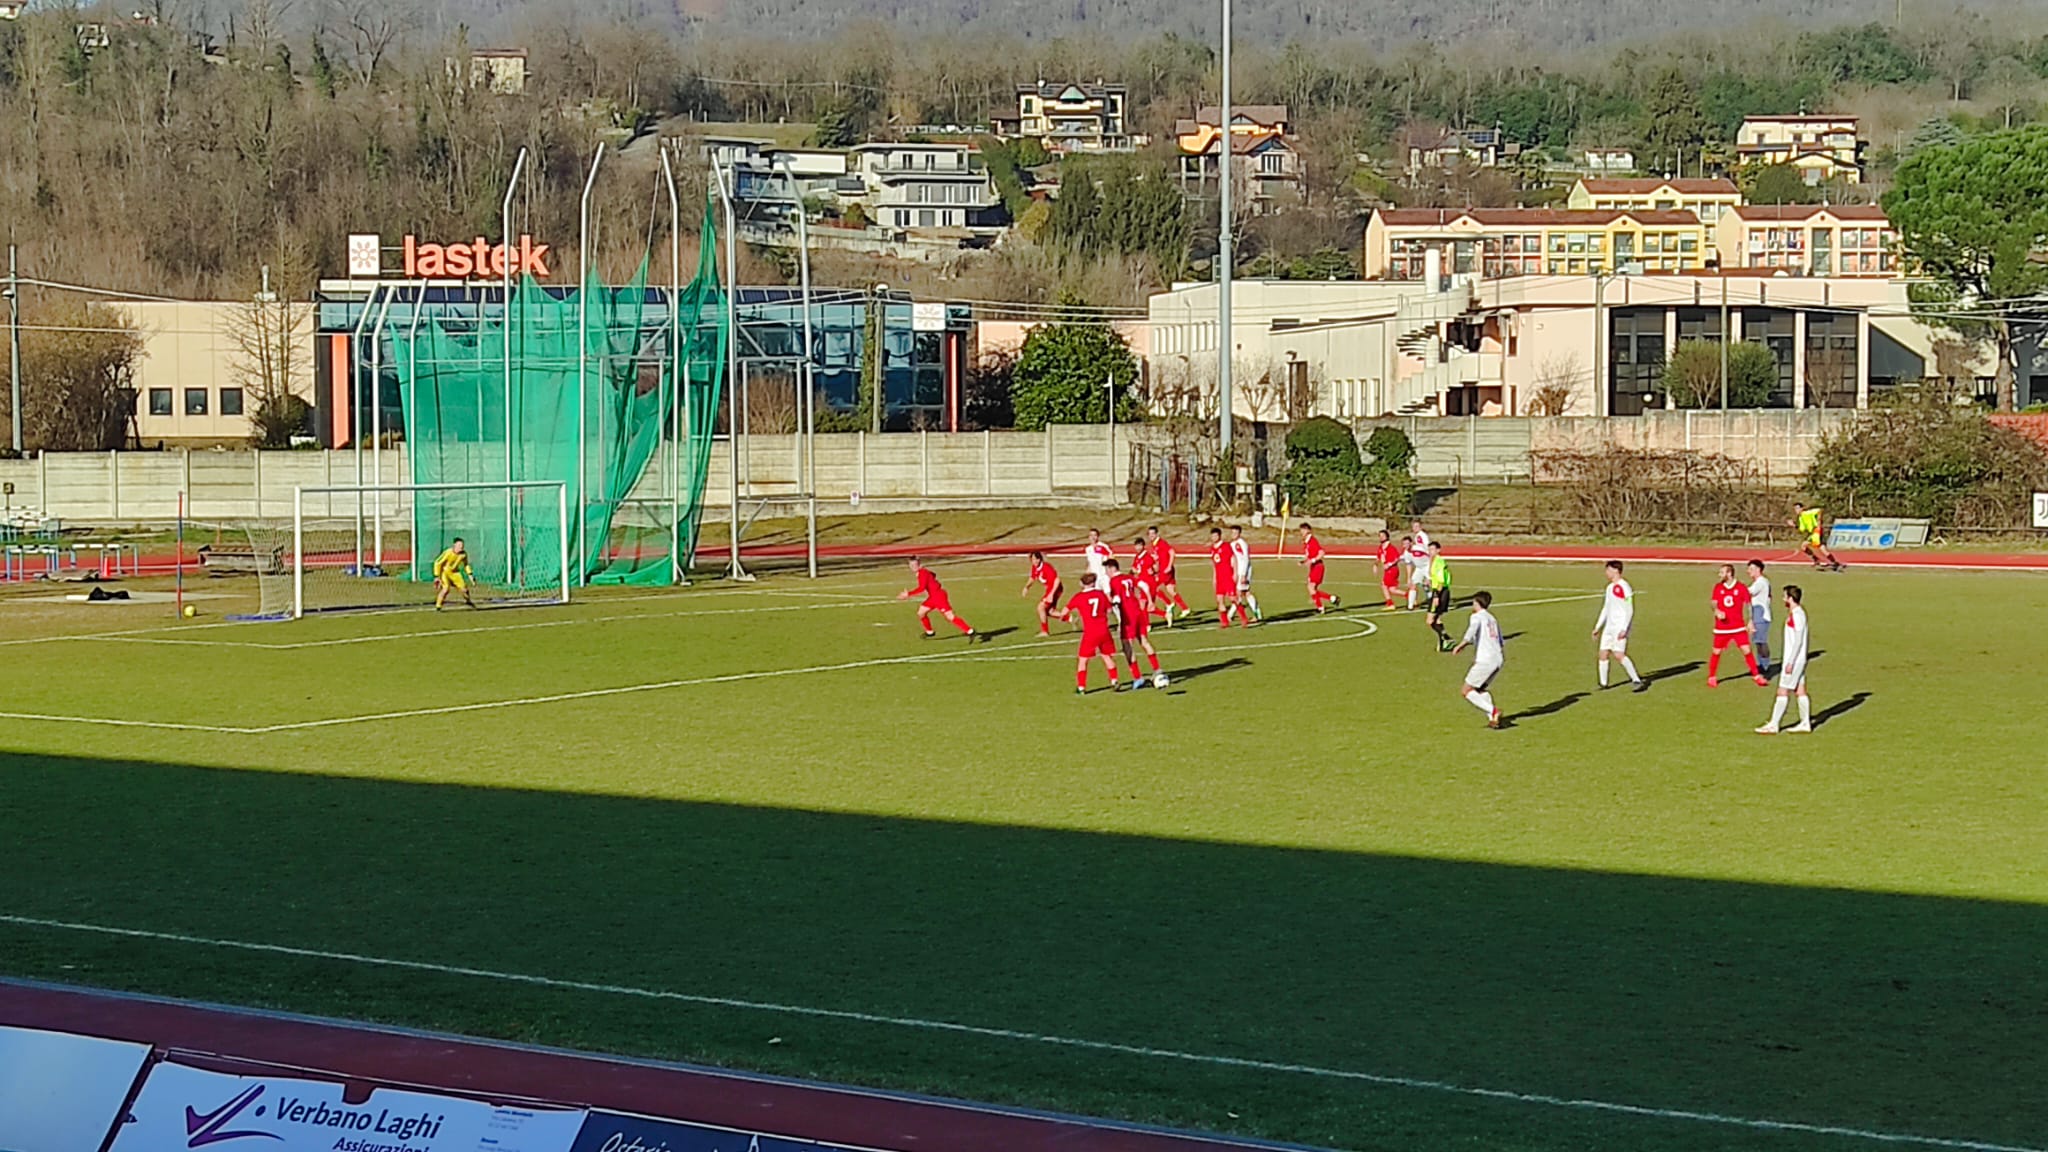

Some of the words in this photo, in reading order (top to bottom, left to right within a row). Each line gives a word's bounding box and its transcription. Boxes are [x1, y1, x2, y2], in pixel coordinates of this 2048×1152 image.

[404, 234, 549, 276] lastek
[1088, 597, 1099, 617] 7
[276, 1097, 372, 1130] Verbano
[374, 1109, 444, 1141] Laghi
[333, 1136, 430, 1152] Assicurazi
